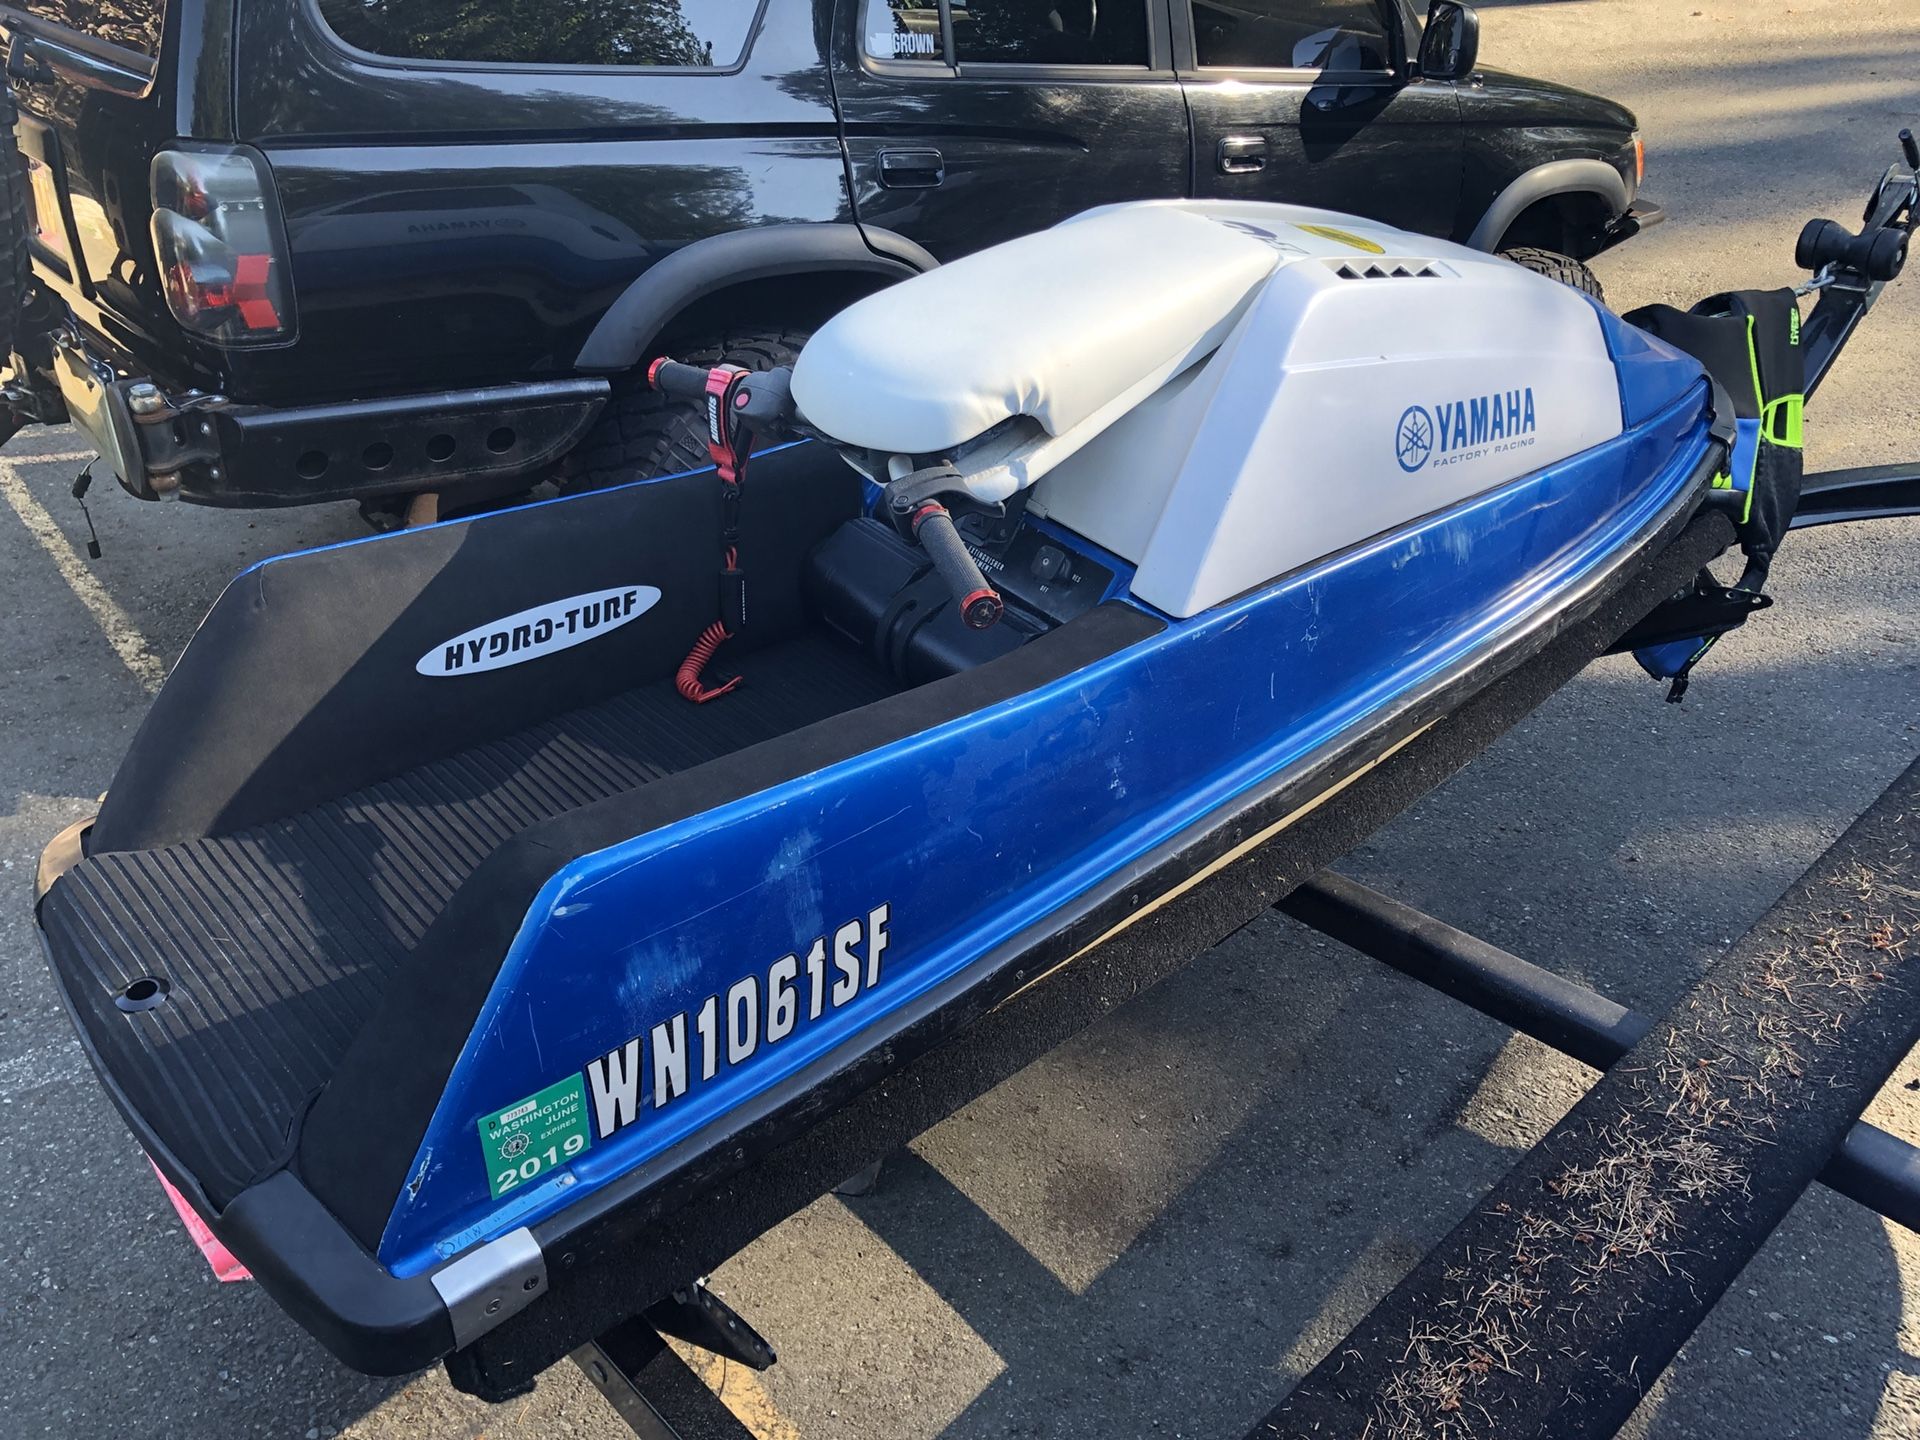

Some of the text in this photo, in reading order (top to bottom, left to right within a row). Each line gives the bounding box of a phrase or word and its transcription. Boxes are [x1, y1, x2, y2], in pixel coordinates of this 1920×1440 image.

[892, 33, 935, 54] GROWN
[1435, 387, 1536, 452] YAMAHA
[1433, 437, 1536, 468] FACTORY RACING
[968, 545, 1005, 571] EXTINGUISHER
[445, 590, 637, 671] HYDRO-TURF
[584, 901, 891, 1140] WN1061SF
[489, 1090, 579, 1140] WASHINGTON
[540, 1117, 577, 1140] EXPIRES
[545, 1102, 579, 1126] JUNE
[496, 1134, 584, 1194] 2019
